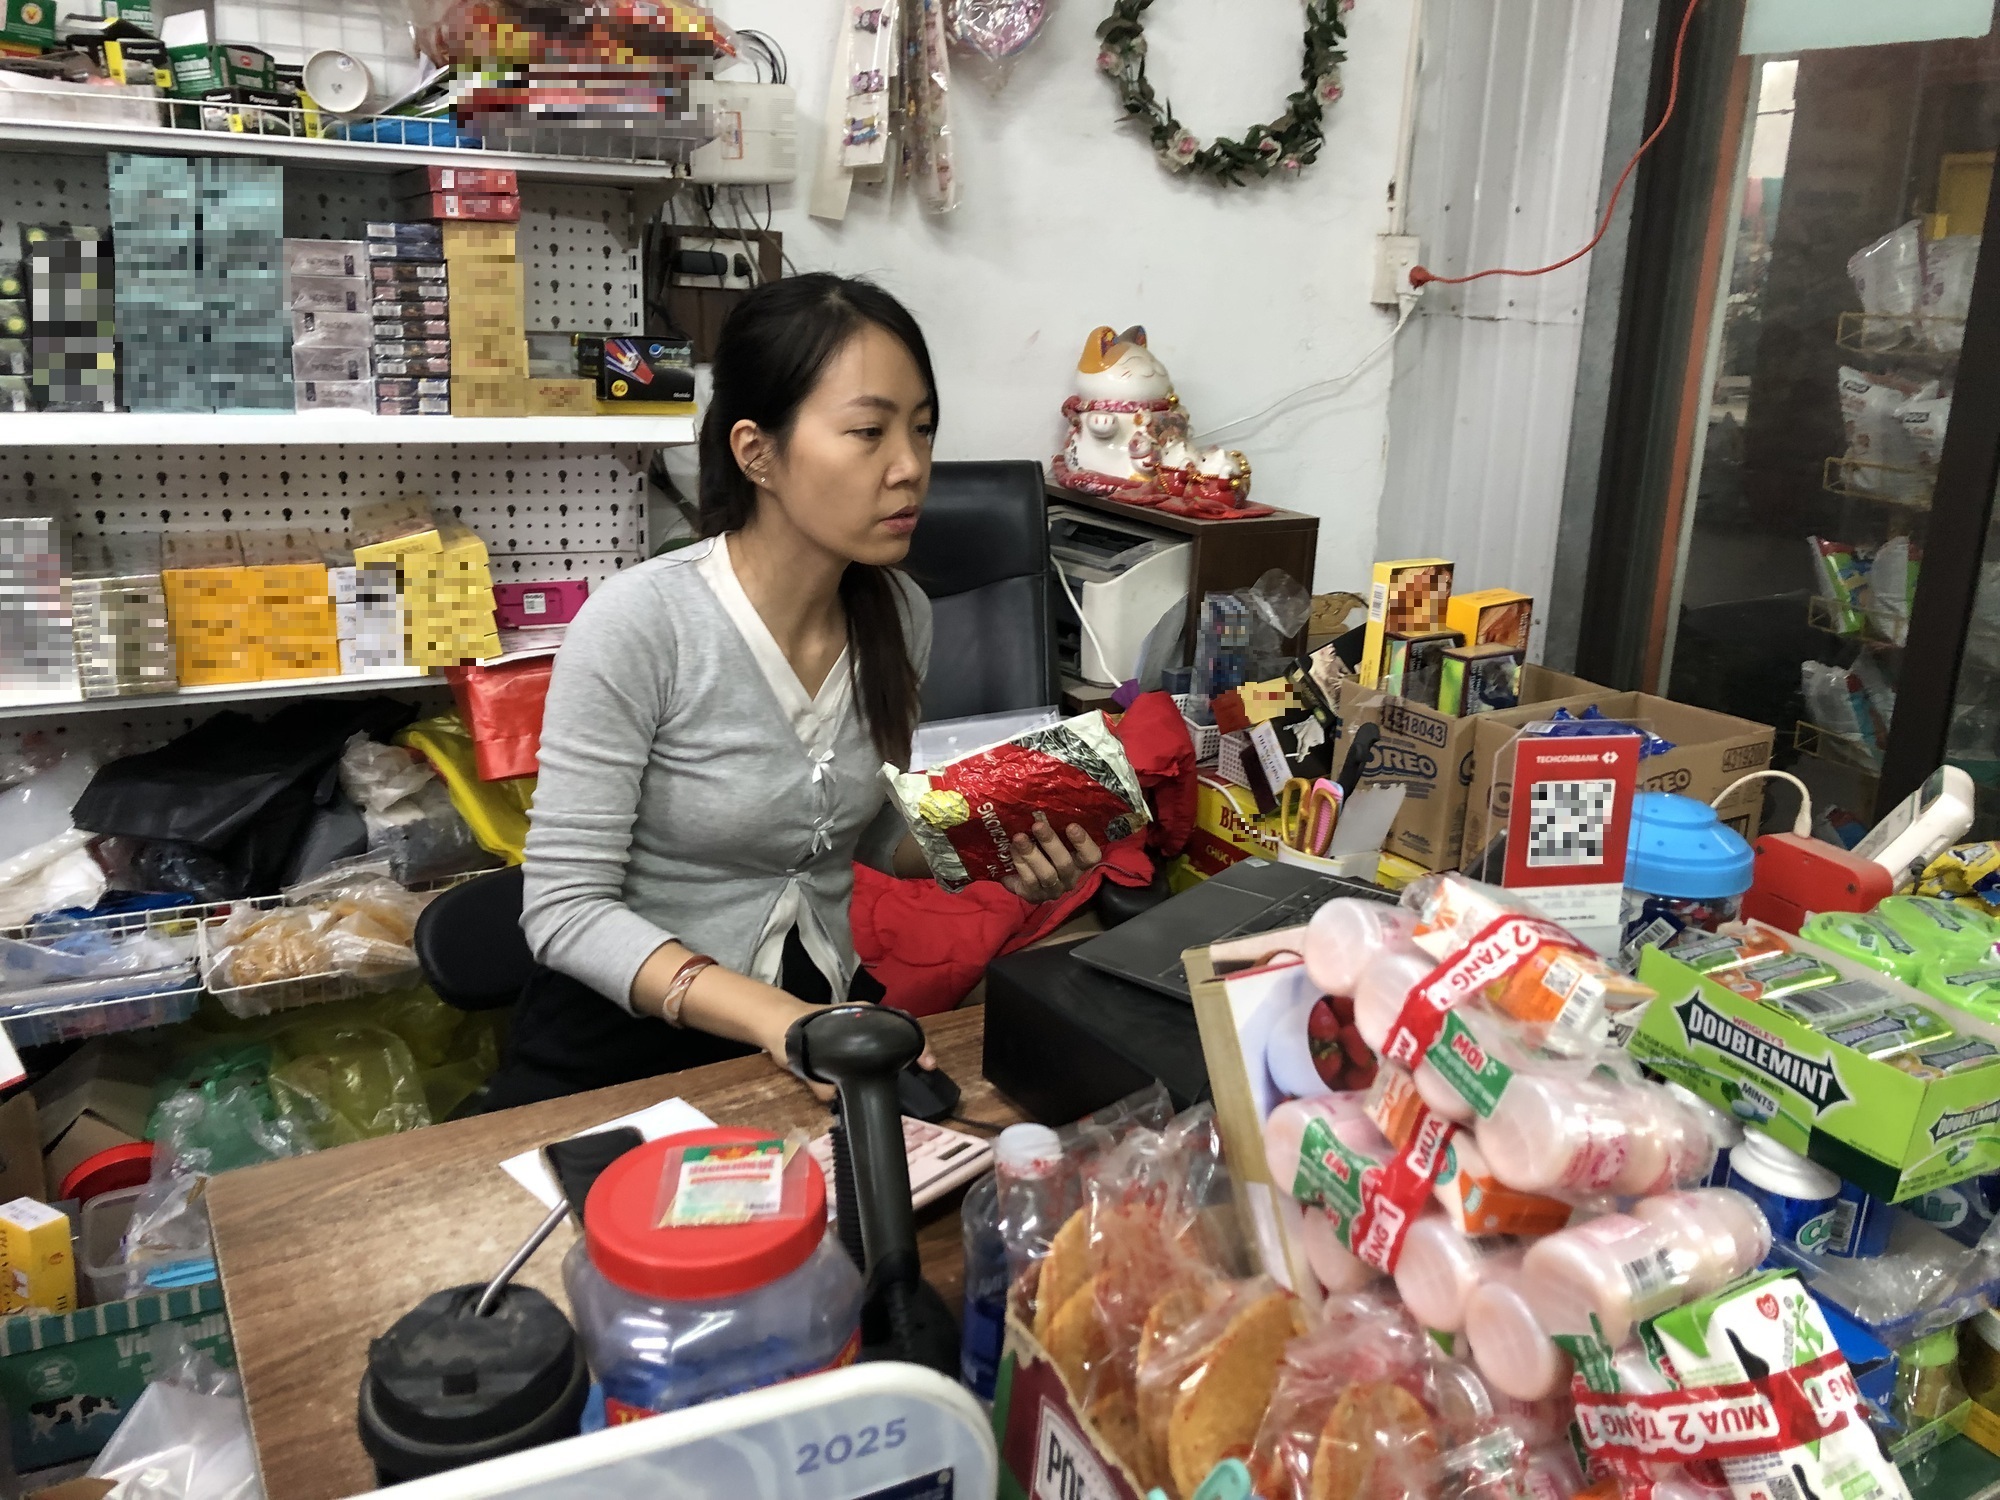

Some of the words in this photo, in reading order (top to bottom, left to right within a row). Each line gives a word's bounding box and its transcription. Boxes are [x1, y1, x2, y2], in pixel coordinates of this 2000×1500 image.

[1536, 753, 1599, 764] TECHCOMBANK
[1646, 767, 1693, 793] REO
[1688, 1002, 1834, 1101] DOUBLEMINT
[1740, 1081, 1776, 1112] MINTS
[1414, 1117, 1445, 1171] MUA
[1379, 1198, 1399, 1221] 1
[1580, 1412, 1599, 1440] 1
[1600, 1408, 1666, 1444] TẶNG
[1668, 1413, 1696, 1445] 2
[1698, 1403, 1771, 1434] MUA
[795, 1417, 908, 1476] 2025
